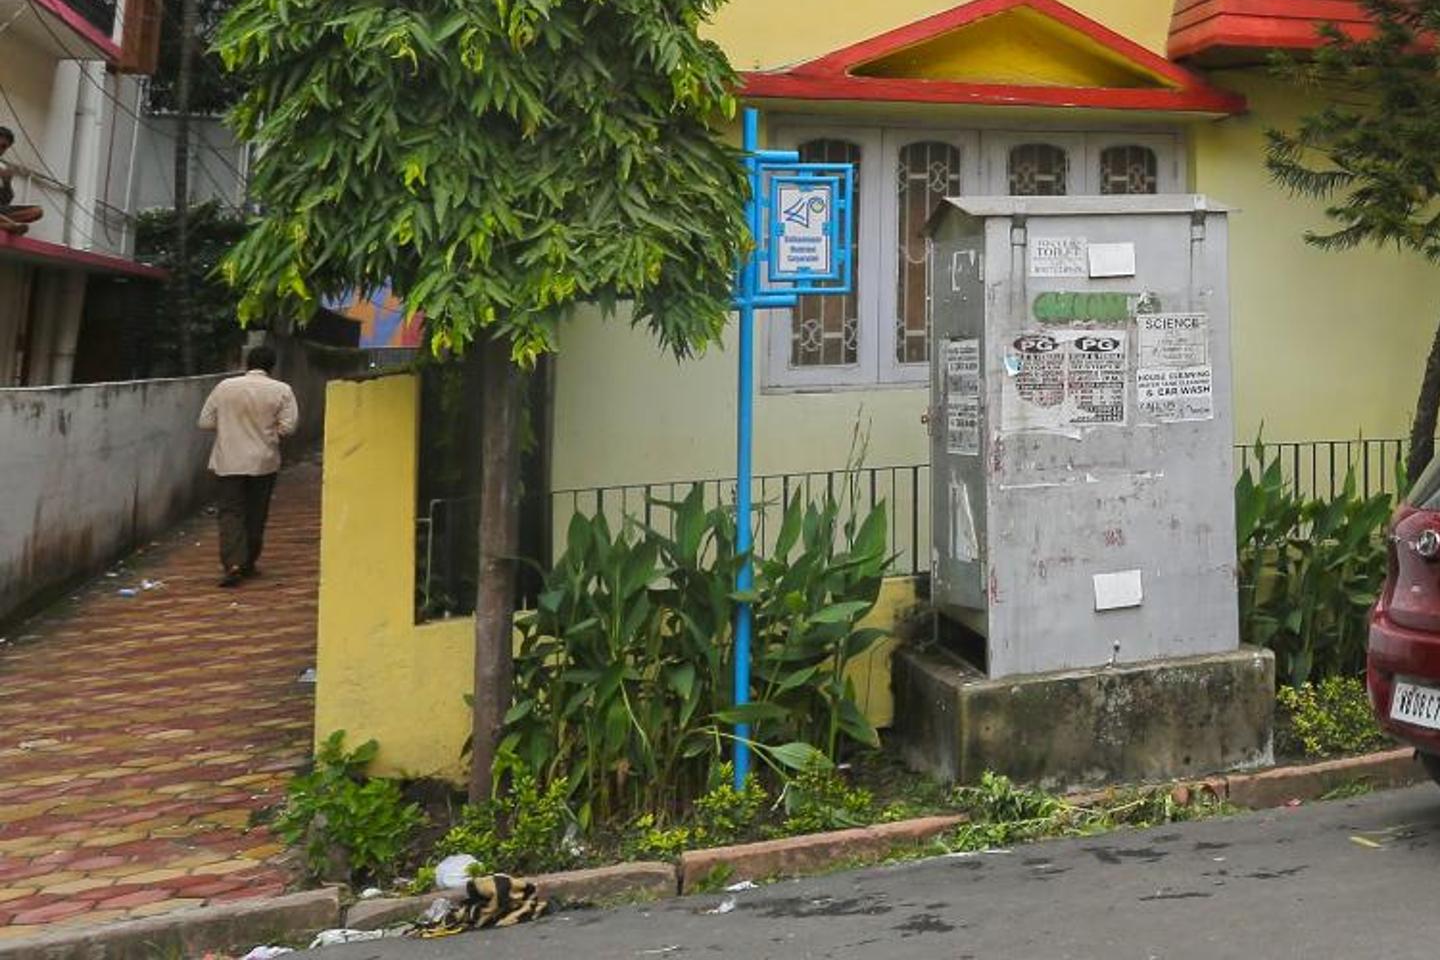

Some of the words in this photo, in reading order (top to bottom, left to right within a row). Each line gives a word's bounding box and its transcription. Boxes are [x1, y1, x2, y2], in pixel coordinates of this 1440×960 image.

[1145, 318, 1200, 330] SCIENCE
[1020, 339, 1054, 351] PG
[1081, 338, 1115, 351] PG
[1157, 388, 1178, 397] CAR
[1180, 385, 1211, 395] WASH
